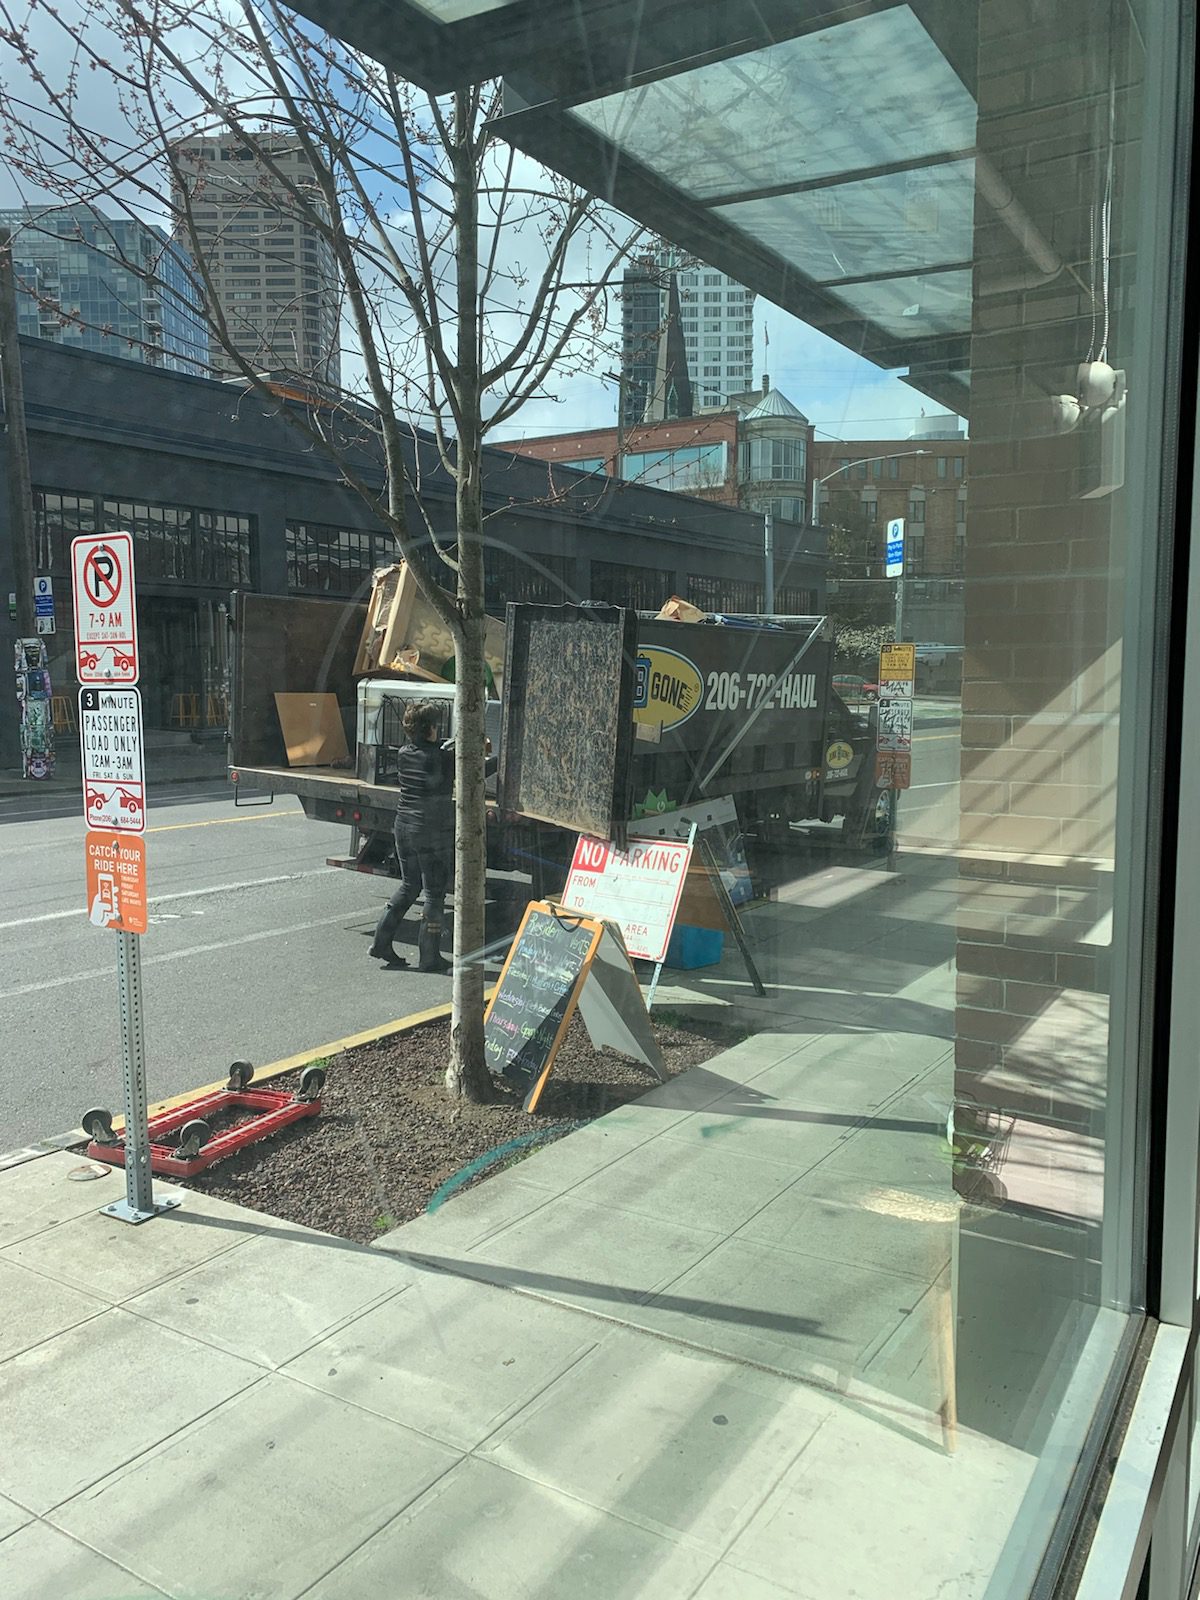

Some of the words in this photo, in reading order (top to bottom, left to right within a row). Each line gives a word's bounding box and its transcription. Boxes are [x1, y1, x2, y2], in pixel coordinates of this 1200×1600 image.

[89, 613, 105, 628] 7-9
[108, 613, 122, 628] AM
[651, 671, 689, 711] GONE
[86, 692, 93, 707] 3
[101, 697, 134, 709] MINUTE
[85, 715, 137, 732] PASSENGER
[86, 735, 109, 751] LOAD
[114, 736, 137, 753] ONLY
[89, 844, 117, 858] CATCH
[119, 848, 141, 862] YOUR
[578, 840, 605, 868] NO
[611, 847, 681, 873] PARKING
[94, 859, 115, 872] RIDE
[116, 861, 138, 876] HERE
[573, 875, 596, 888] FROM
[573, 896, 584, 908] TO
[624, 924, 648, 936] AREA
